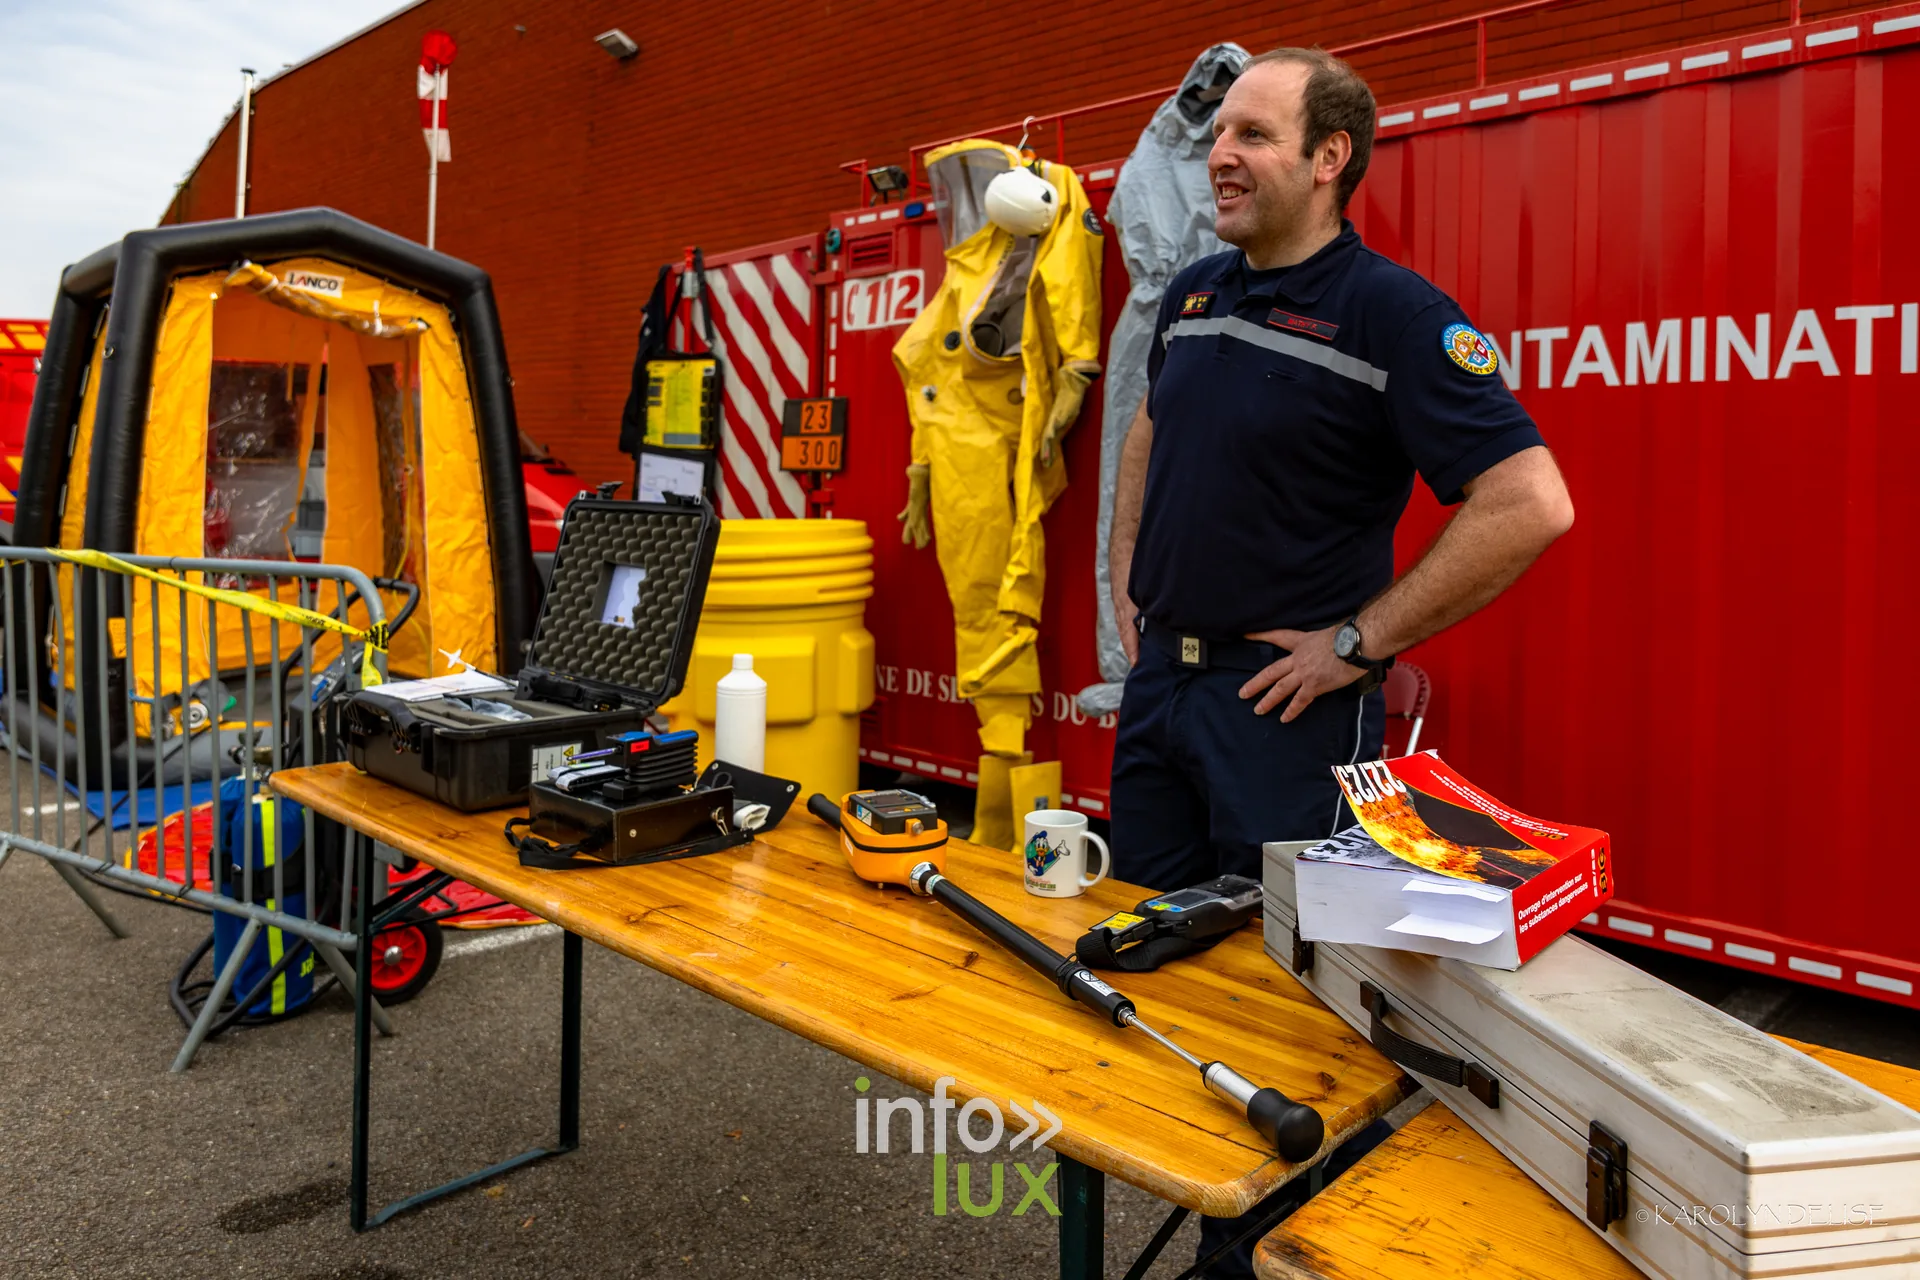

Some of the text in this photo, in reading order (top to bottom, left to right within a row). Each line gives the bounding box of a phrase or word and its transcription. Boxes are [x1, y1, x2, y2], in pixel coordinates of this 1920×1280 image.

[288, 272, 339, 291] LANCO
[867, 274, 920, 326] 112
[1448, 350, 1484, 374] BRABANT
[1484, 302, 1919, 391] NTAMINATI
[803, 404, 829, 430] 23
[799, 440, 839, 466] 300
[906, 667, 934, 698] DE
[1518, 872, 1583, 920] Ouvrage d'intervention sur
[1519, 881, 1589, 934] les substances dangereuses
